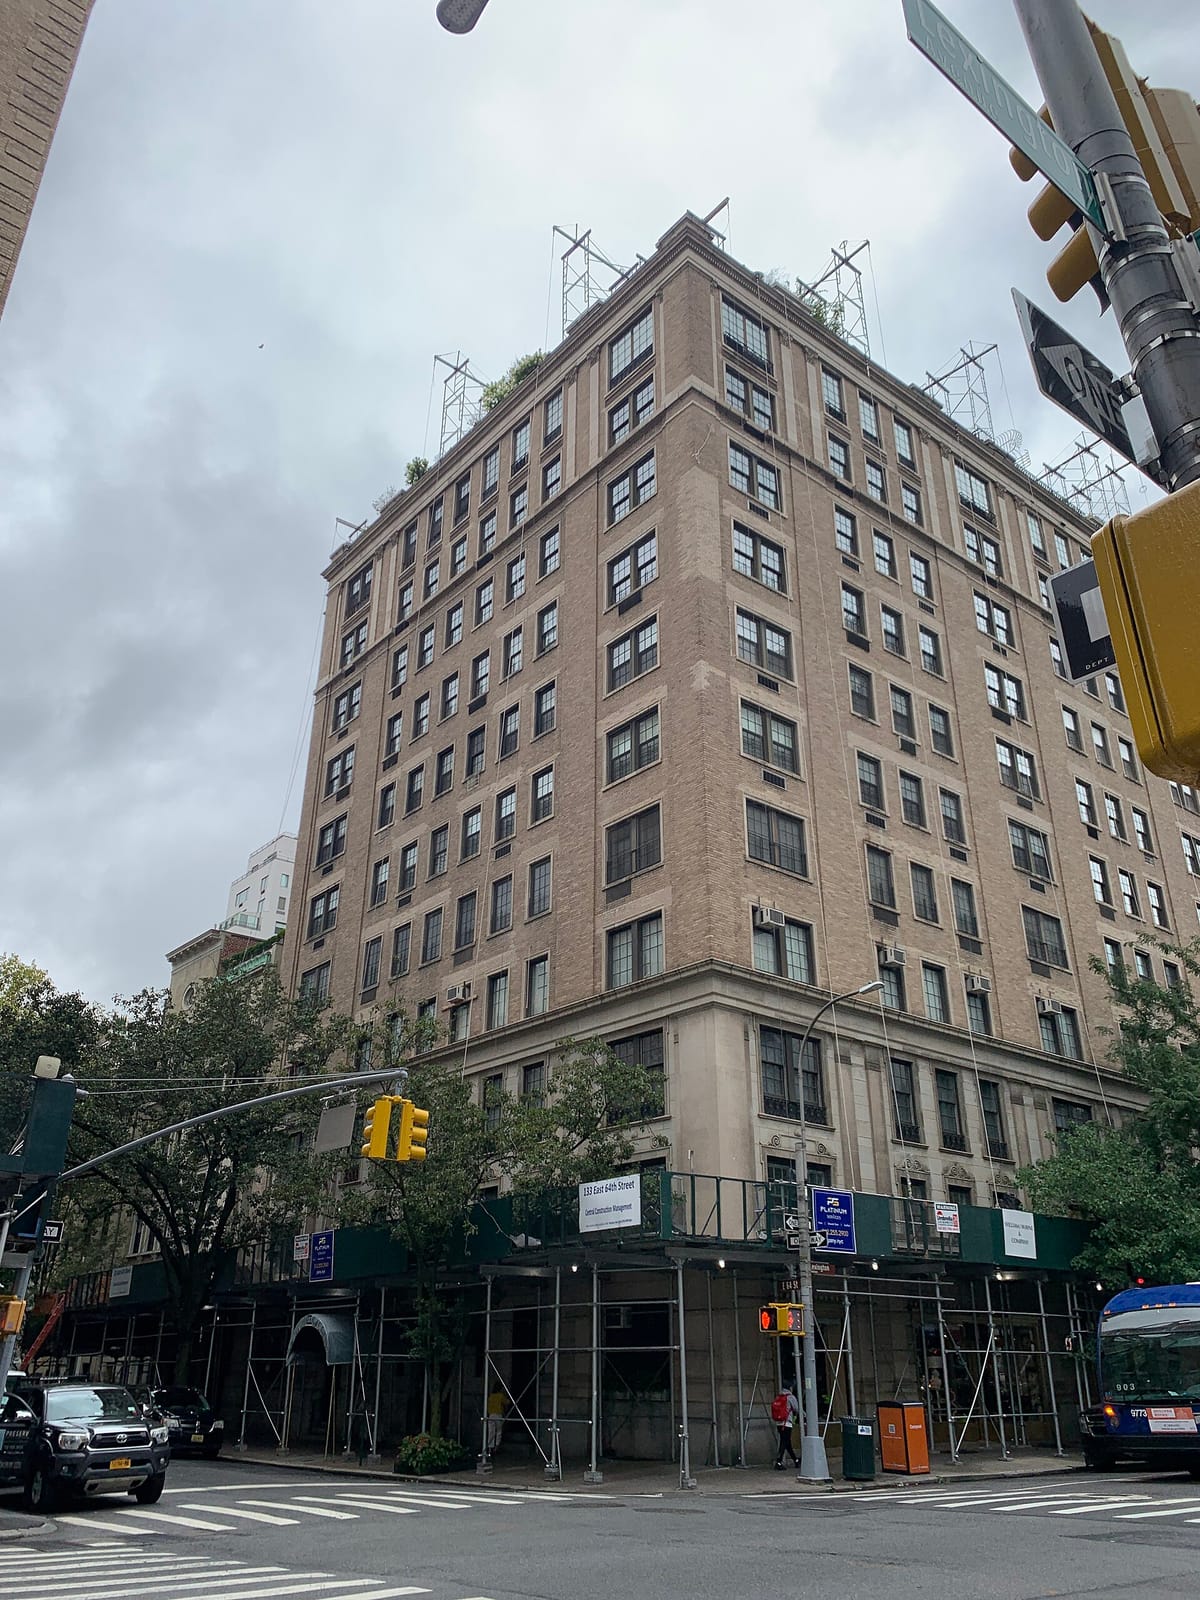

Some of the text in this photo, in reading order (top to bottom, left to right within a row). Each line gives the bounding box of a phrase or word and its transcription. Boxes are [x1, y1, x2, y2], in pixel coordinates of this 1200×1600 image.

[1063, 356, 1125, 433] ONE
[1085, 656, 1109, 670] DEPT
[584, 1181, 635, 1197] 133 East 64th Street
[820, 1206, 847, 1214] PLATINUM
[1116, 1383, 1135, 1391] 903
[1130, 1409, 1147, 1417] 9773
